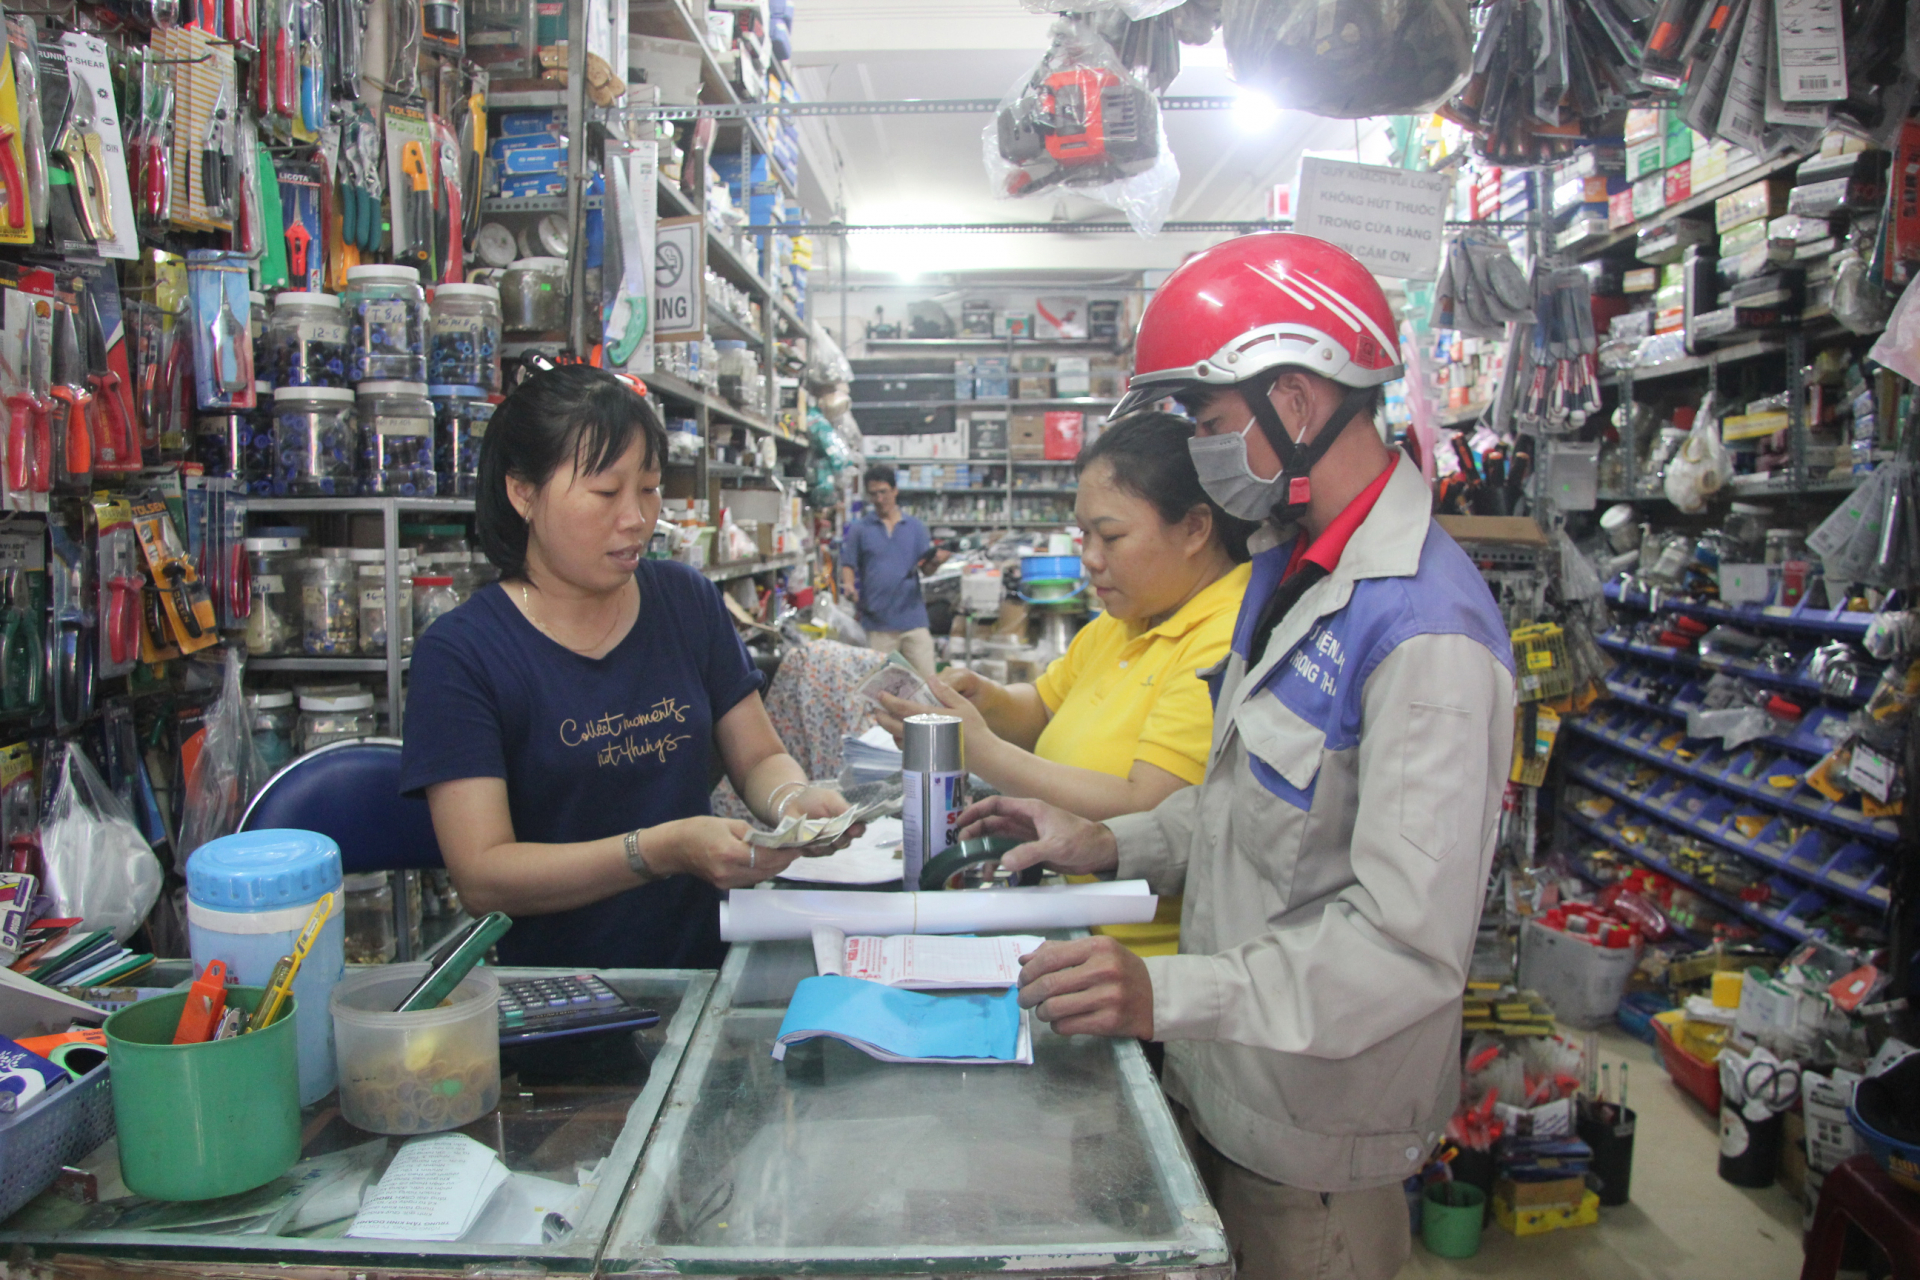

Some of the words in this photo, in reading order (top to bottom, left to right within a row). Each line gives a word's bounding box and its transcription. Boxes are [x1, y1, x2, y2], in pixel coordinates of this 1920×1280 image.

[37, 50, 73, 62] RUNING
[75, 57, 105, 69] SHEAR
[105, 144, 119, 153] DIN
[279, 172, 310, 182] LICOTA
[1318, 214, 1362, 231] TRONG
[656, 296, 687, 320] ING
[131, 502, 168, 516] TOLSEN
[1289, 648, 1321, 684] RỌNG
[560, 711, 625, 747] Collect
[623, 697, 691, 723] moments
[597, 741, 622, 767] not
[619, 734, 692, 763] things
